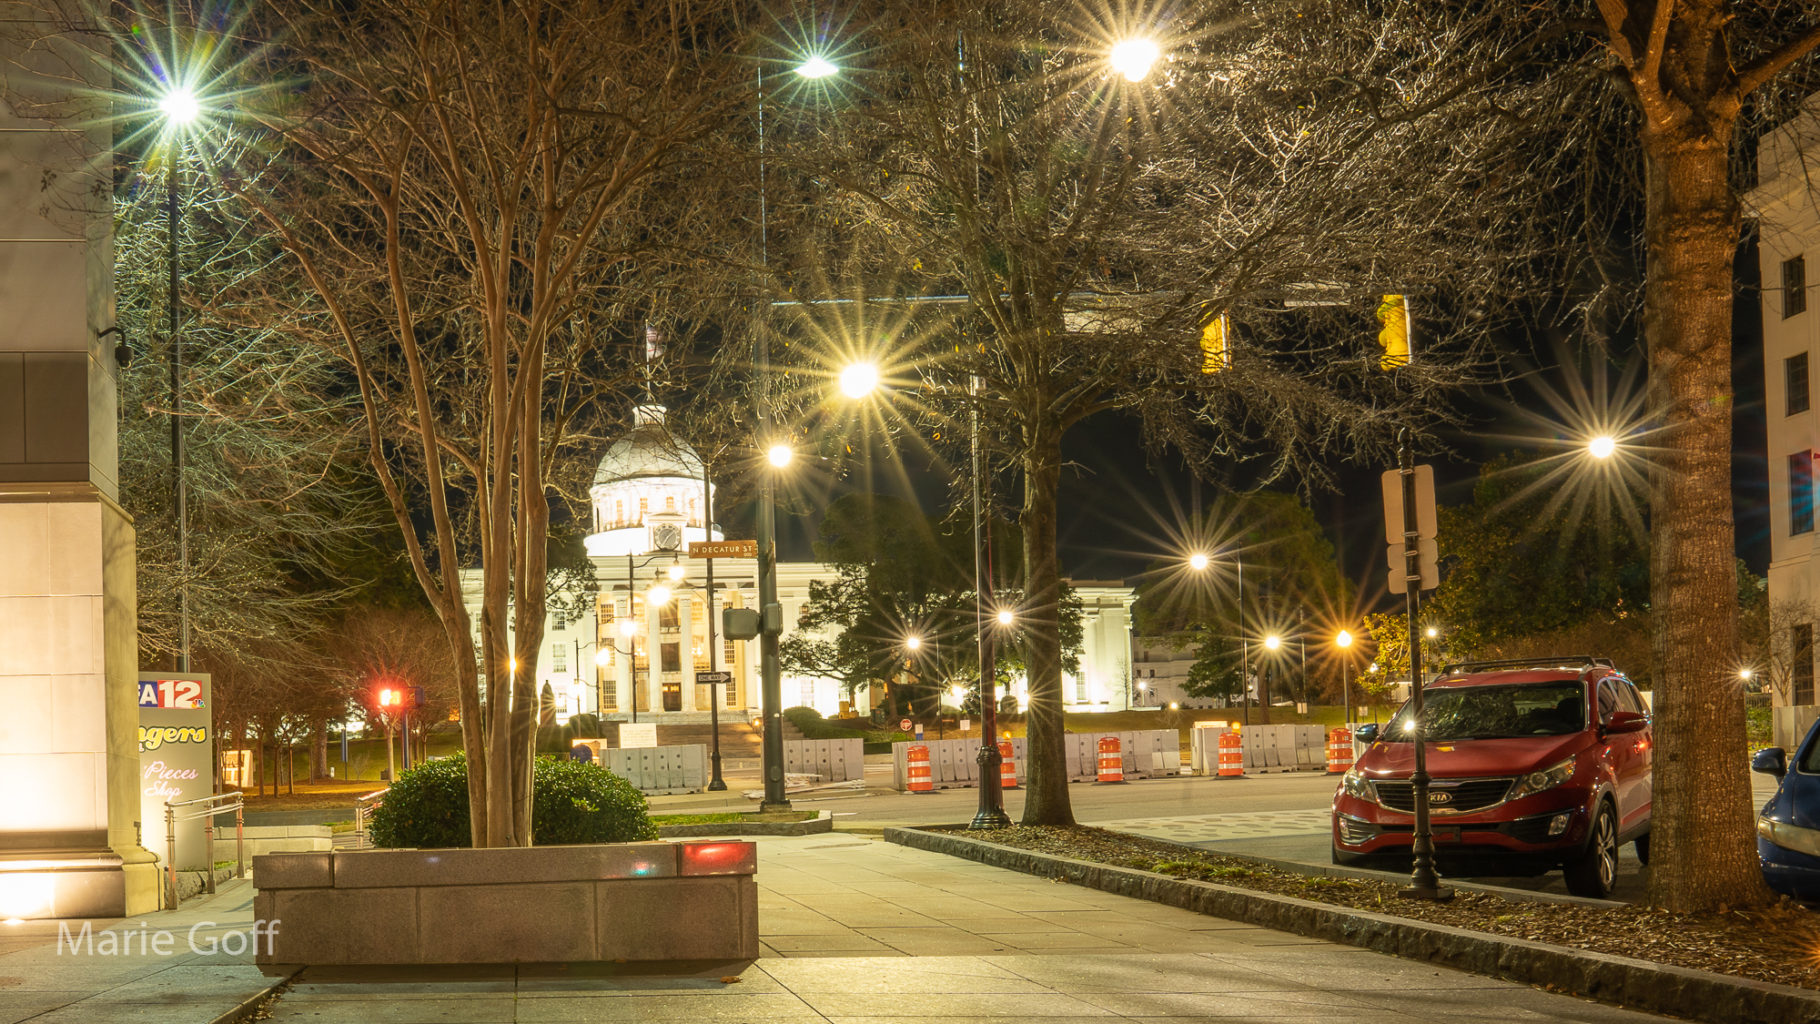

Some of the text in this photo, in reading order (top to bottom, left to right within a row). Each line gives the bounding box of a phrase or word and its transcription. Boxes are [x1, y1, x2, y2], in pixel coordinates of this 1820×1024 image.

[138, 684, 158, 704] A
[144, 761, 199, 779] Pieces
[144, 780, 183, 802] Shop
